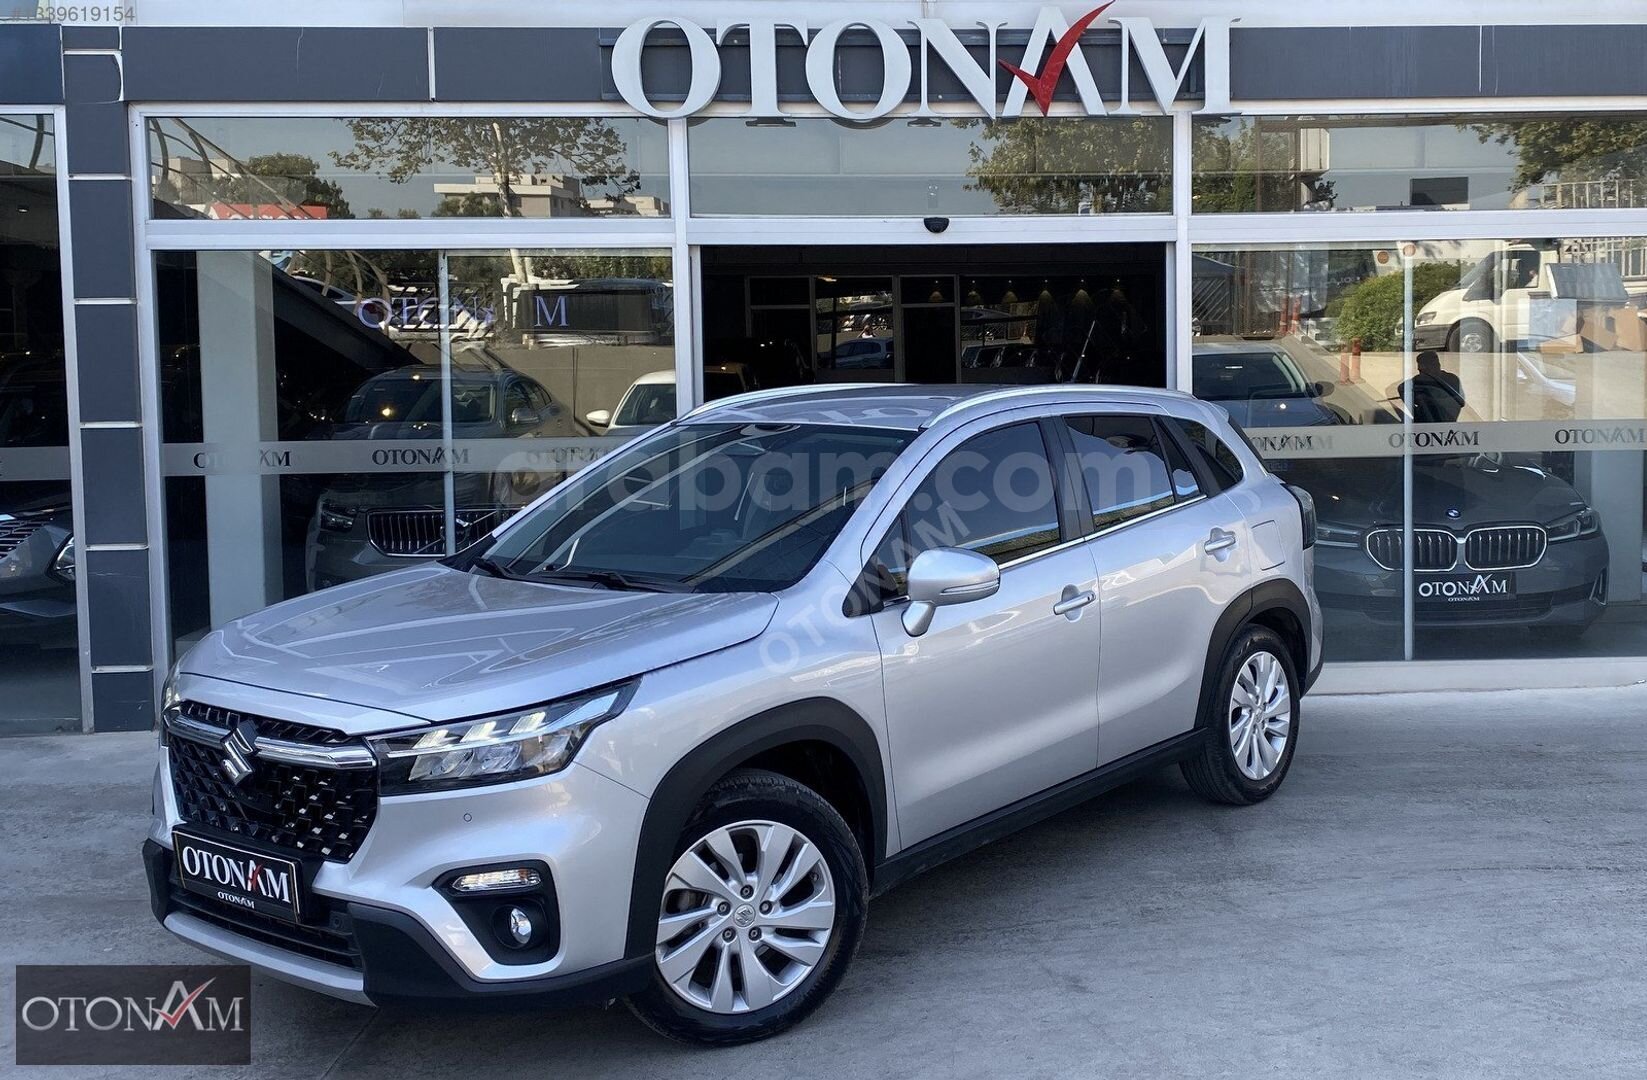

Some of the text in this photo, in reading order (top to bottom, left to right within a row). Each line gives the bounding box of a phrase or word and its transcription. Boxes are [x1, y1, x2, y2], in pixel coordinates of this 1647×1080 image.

[611, 2, 1241, 119] OTONAM
[1388, 429, 1479, 448] OTONAM
[1554, 426, 1645, 445] OTONAM
[371, 446, 470, 466] OTONAM
[1418, 574, 1508, 597] OTONAM
[182, 845, 291, 904] OTONAM
[217, 891, 255, 909] OTONAM
